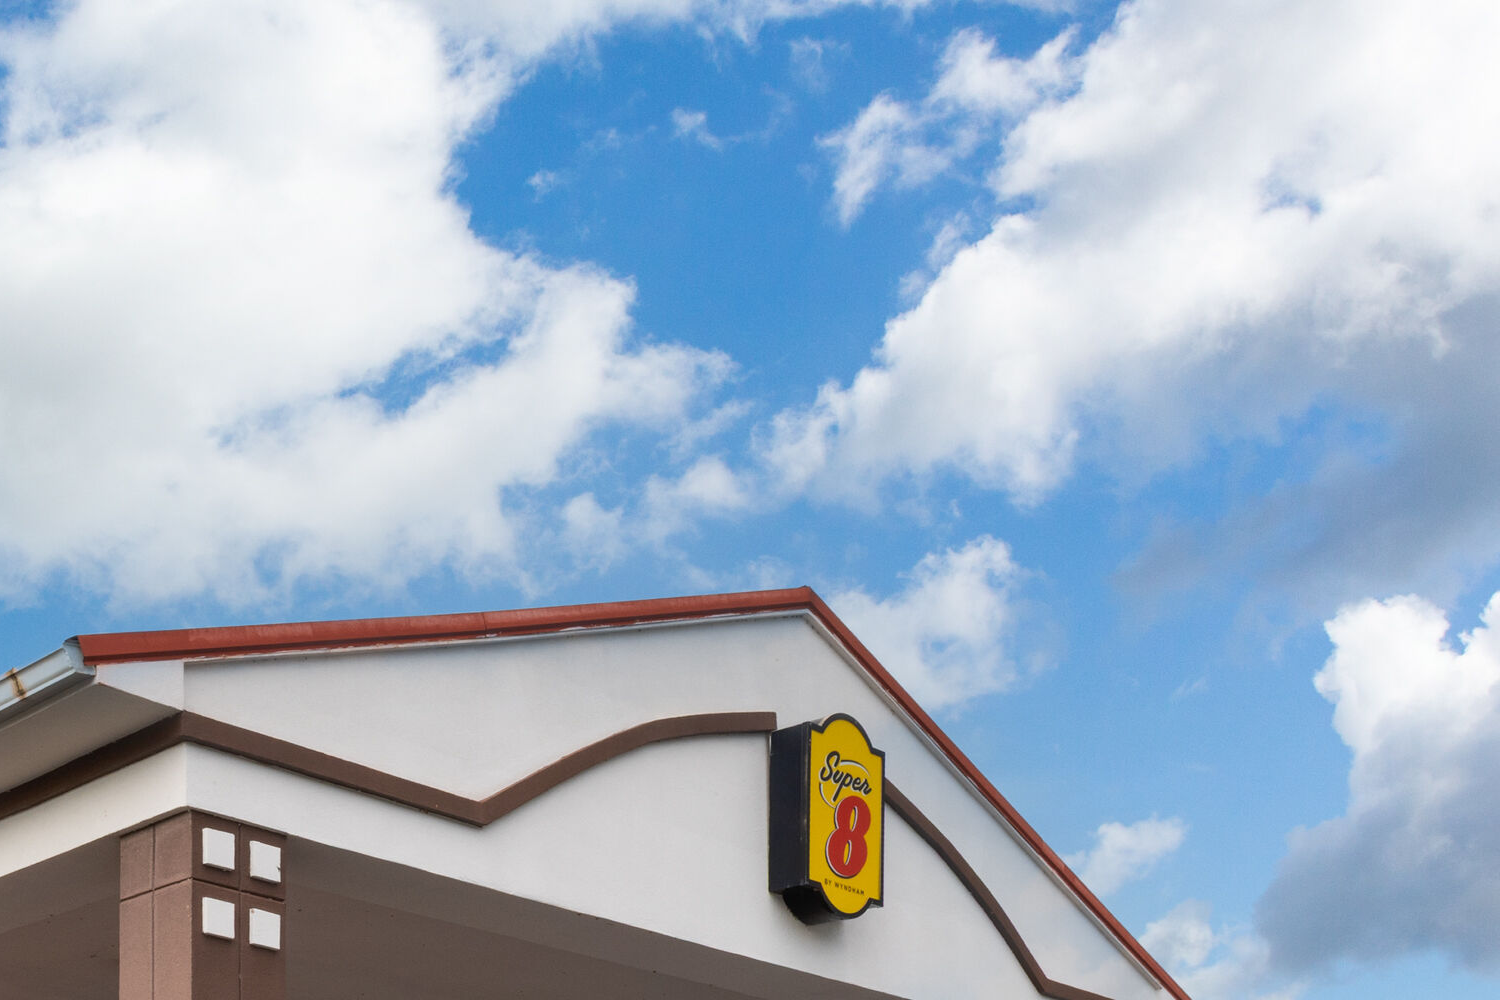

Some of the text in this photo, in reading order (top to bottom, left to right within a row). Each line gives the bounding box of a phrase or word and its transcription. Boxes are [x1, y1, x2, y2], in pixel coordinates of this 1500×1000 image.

[819, 750, 872, 802] Super
[825, 795, 871, 879] 8
[824, 878, 865, 896] BY WYNDHAM
